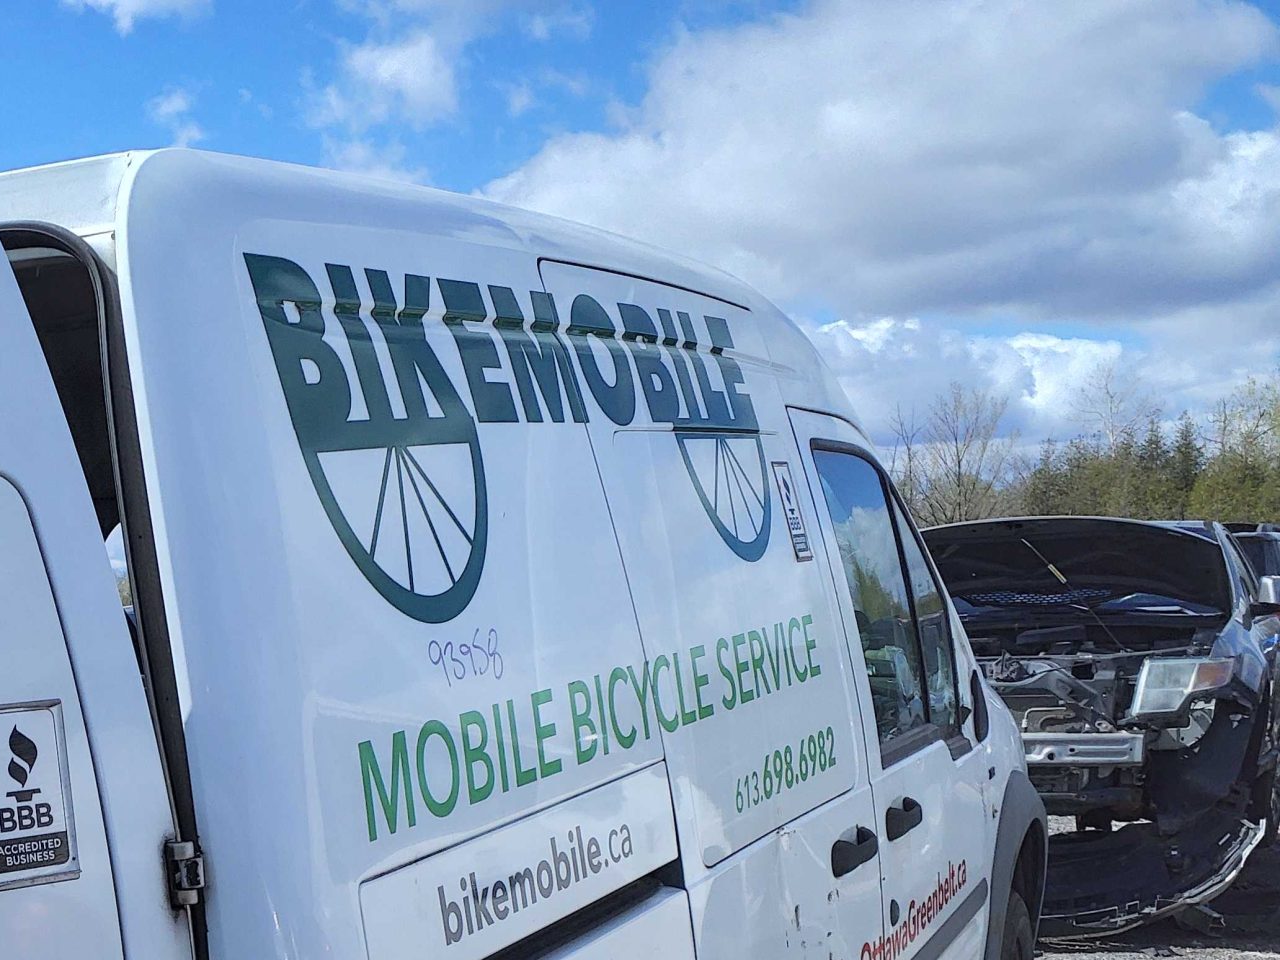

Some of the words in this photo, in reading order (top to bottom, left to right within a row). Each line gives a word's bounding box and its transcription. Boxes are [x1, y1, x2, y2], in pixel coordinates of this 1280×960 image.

[243, 252, 760, 450] BIKEMOBILE
[428, 628, 504, 687] 93958
[358, 688, 562, 842] MOBILE
[567, 645, 714, 766] BICYCLE
[716, 614, 821, 711] SERVICE
[736, 726, 836, 813] 613.698.6982
[6, 850, 55, 866] BUSINESS
[437, 823, 634, 946] bikemobile.ca
